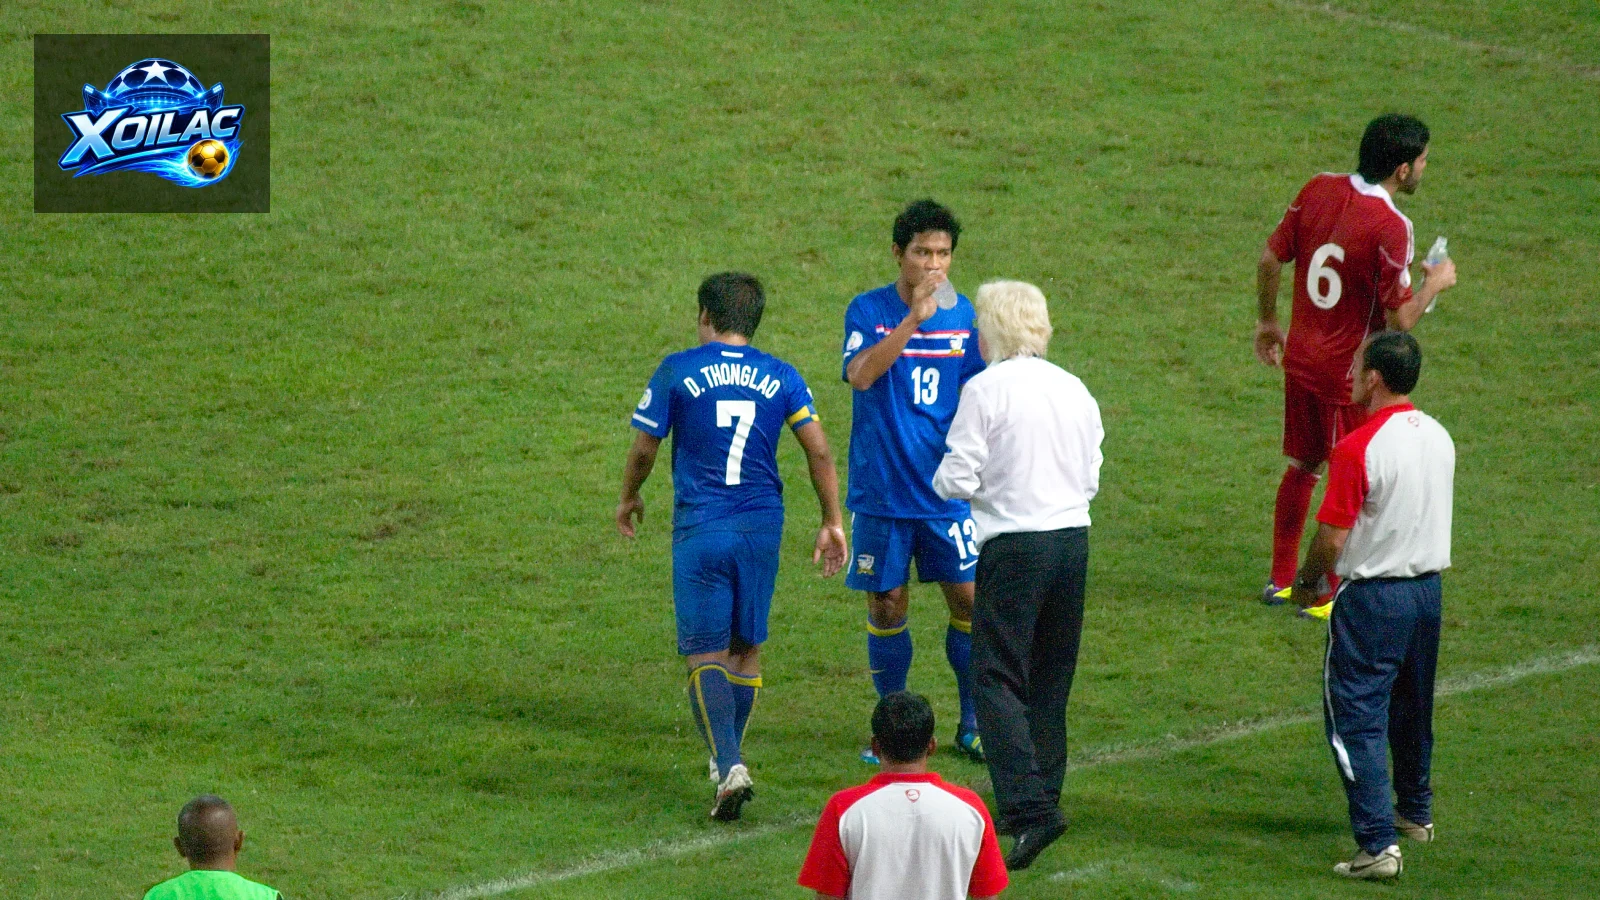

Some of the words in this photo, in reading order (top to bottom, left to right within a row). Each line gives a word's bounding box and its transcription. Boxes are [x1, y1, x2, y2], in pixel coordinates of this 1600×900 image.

[1306, 242, 1345, 310] 6
[683, 376, 706, 398] D.
[700, 363, 781, 399] THONGLAO
[911, 366, 940, 406] 13
[716, 400, 756, 485] 7
[947, 518, 980, 560] 13
